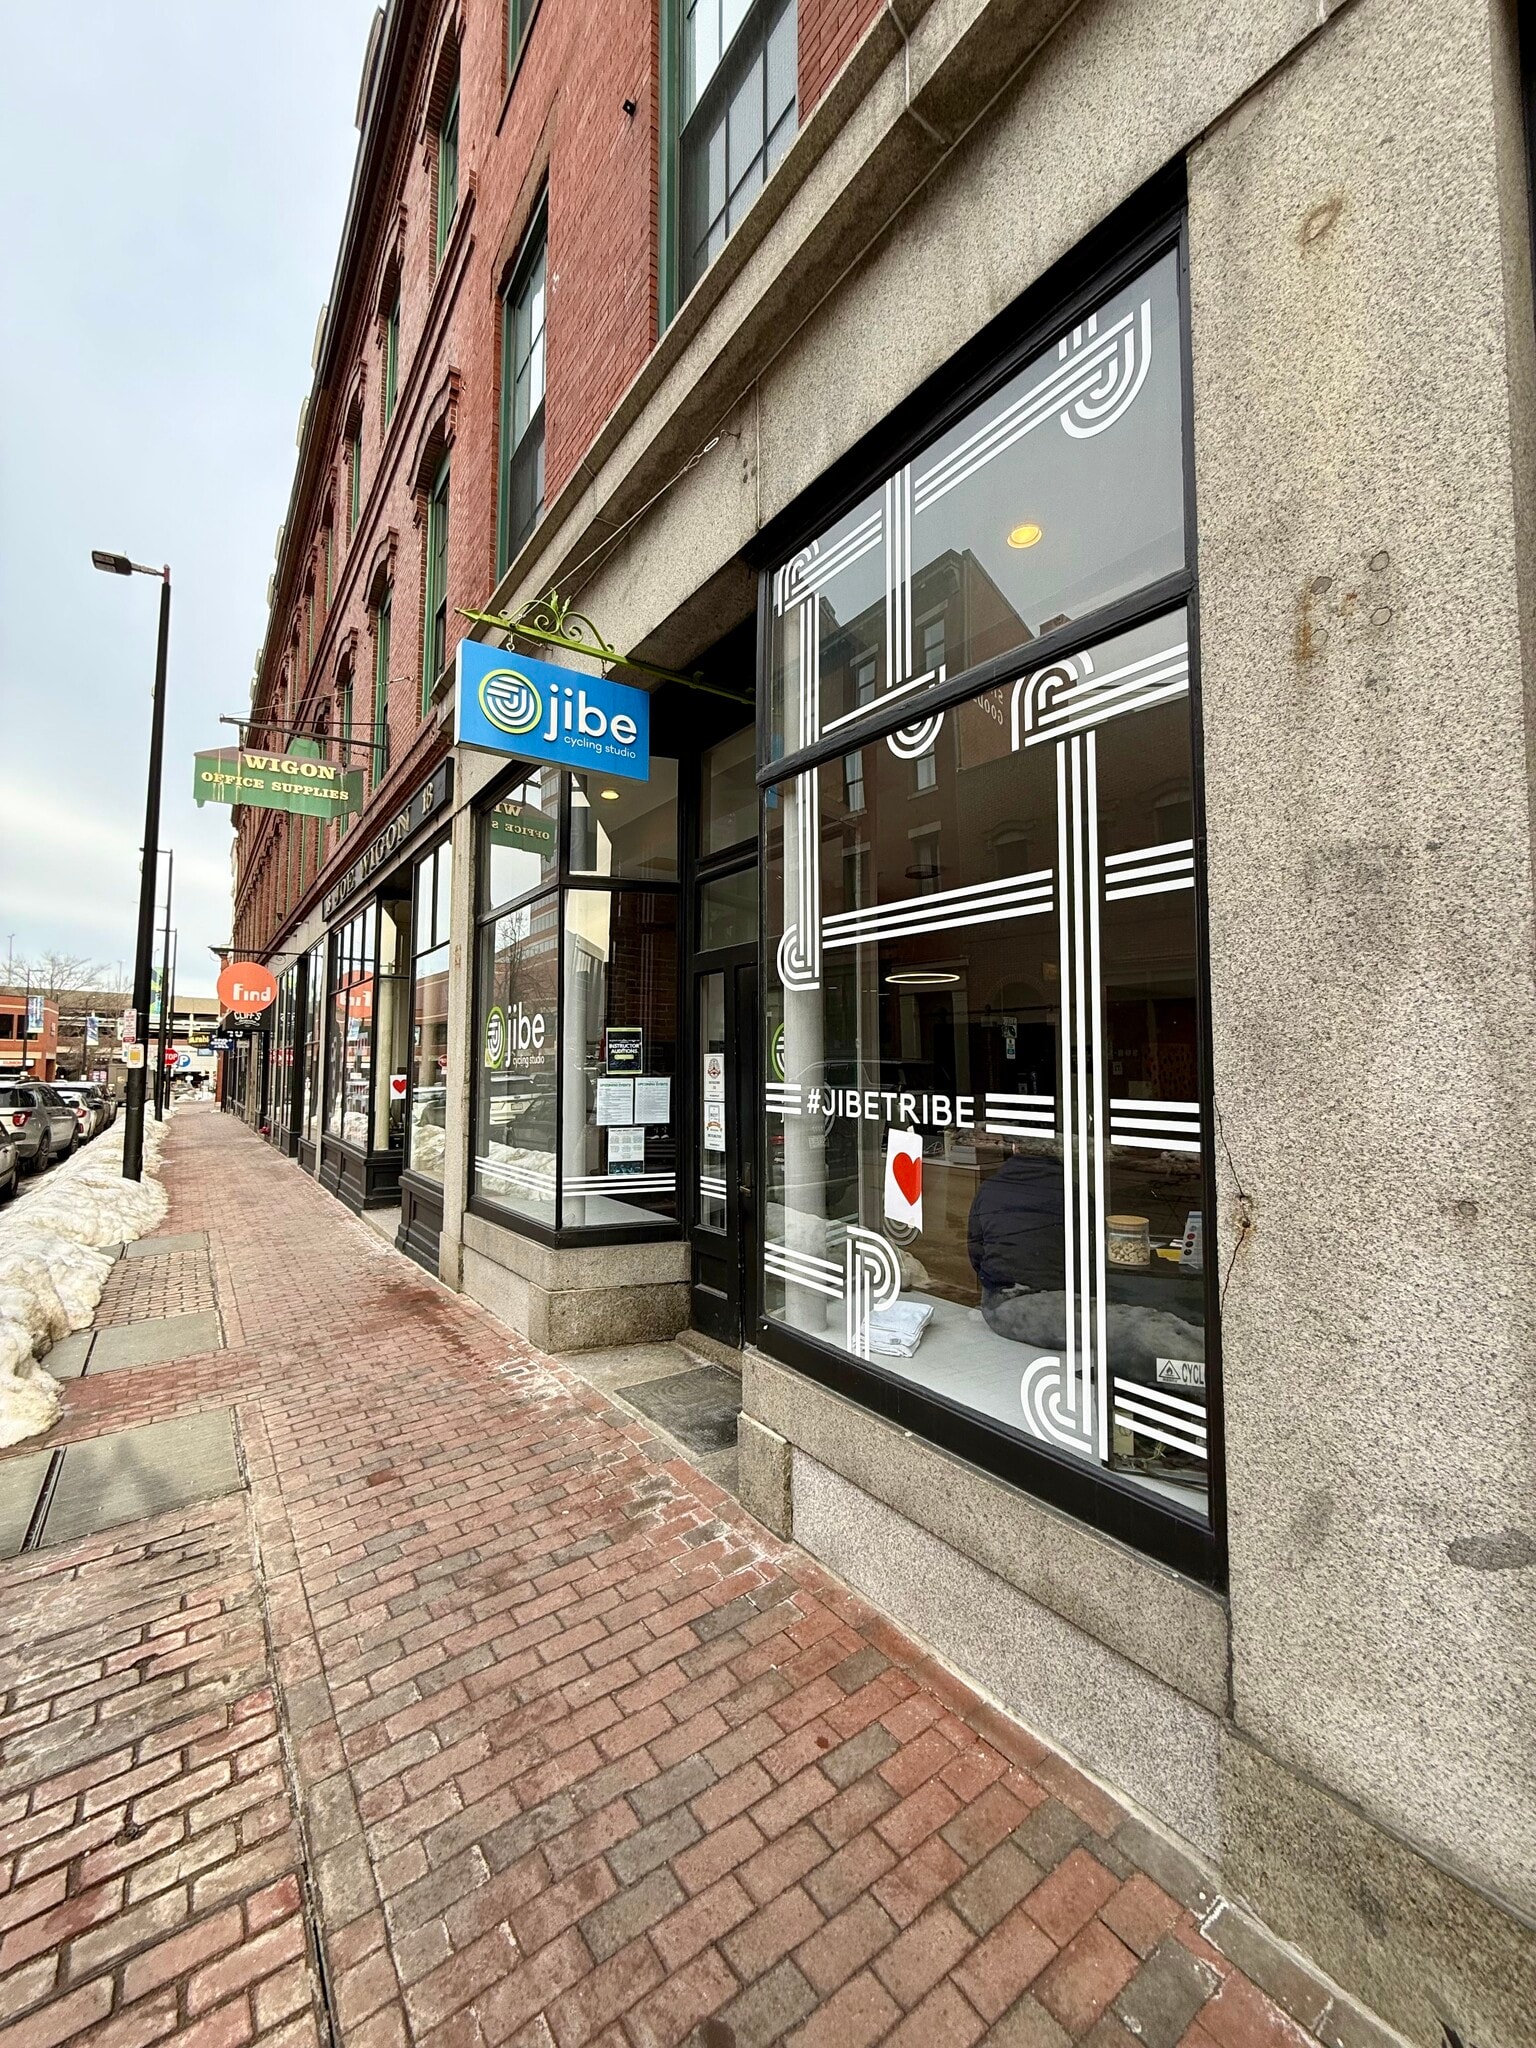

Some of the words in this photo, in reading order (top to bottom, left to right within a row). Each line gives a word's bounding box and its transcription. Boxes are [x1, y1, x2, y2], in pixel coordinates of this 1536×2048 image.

[543, 683, 637, 745] jibe
[243, 753, 337, 781] WIGON
[564, 735, 602, 754] cycling
[605, 745, 636, 759] studio
[201, 771, 264, 790] OFFICE
[271, 781, 349, 801] SUPPLIES
[335, 869, 357, 906] JOE
[360, 804, 412, 879] WIGON
[505, 1001, 545, 1068] jibe
[806, 1087, 976, 1129] #JIBETRIBE
